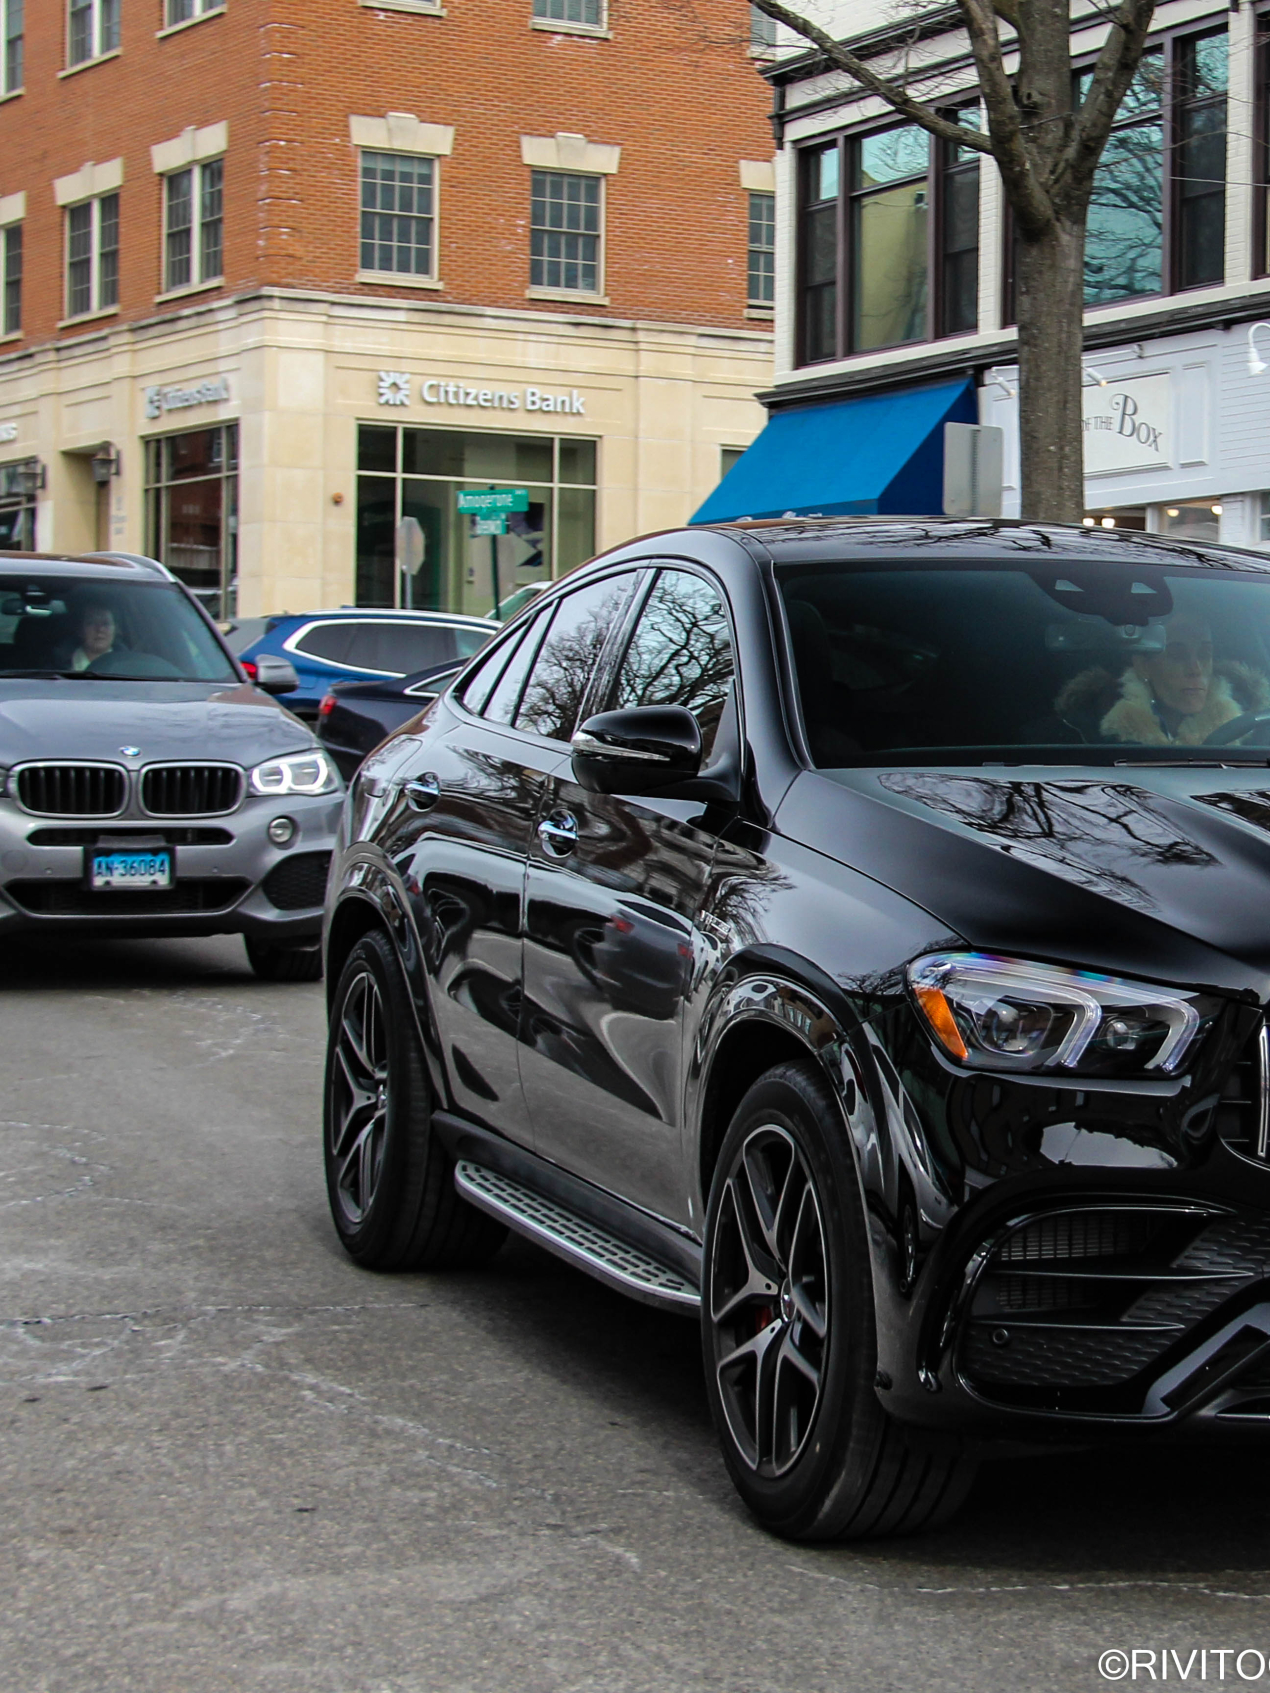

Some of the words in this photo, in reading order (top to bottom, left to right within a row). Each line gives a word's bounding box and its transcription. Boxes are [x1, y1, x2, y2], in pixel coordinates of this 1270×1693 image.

[421, 379, 520, 409] Citizens
[525, 388, 585, 414] Bank
[1093, 415, 1114, 431] THE
